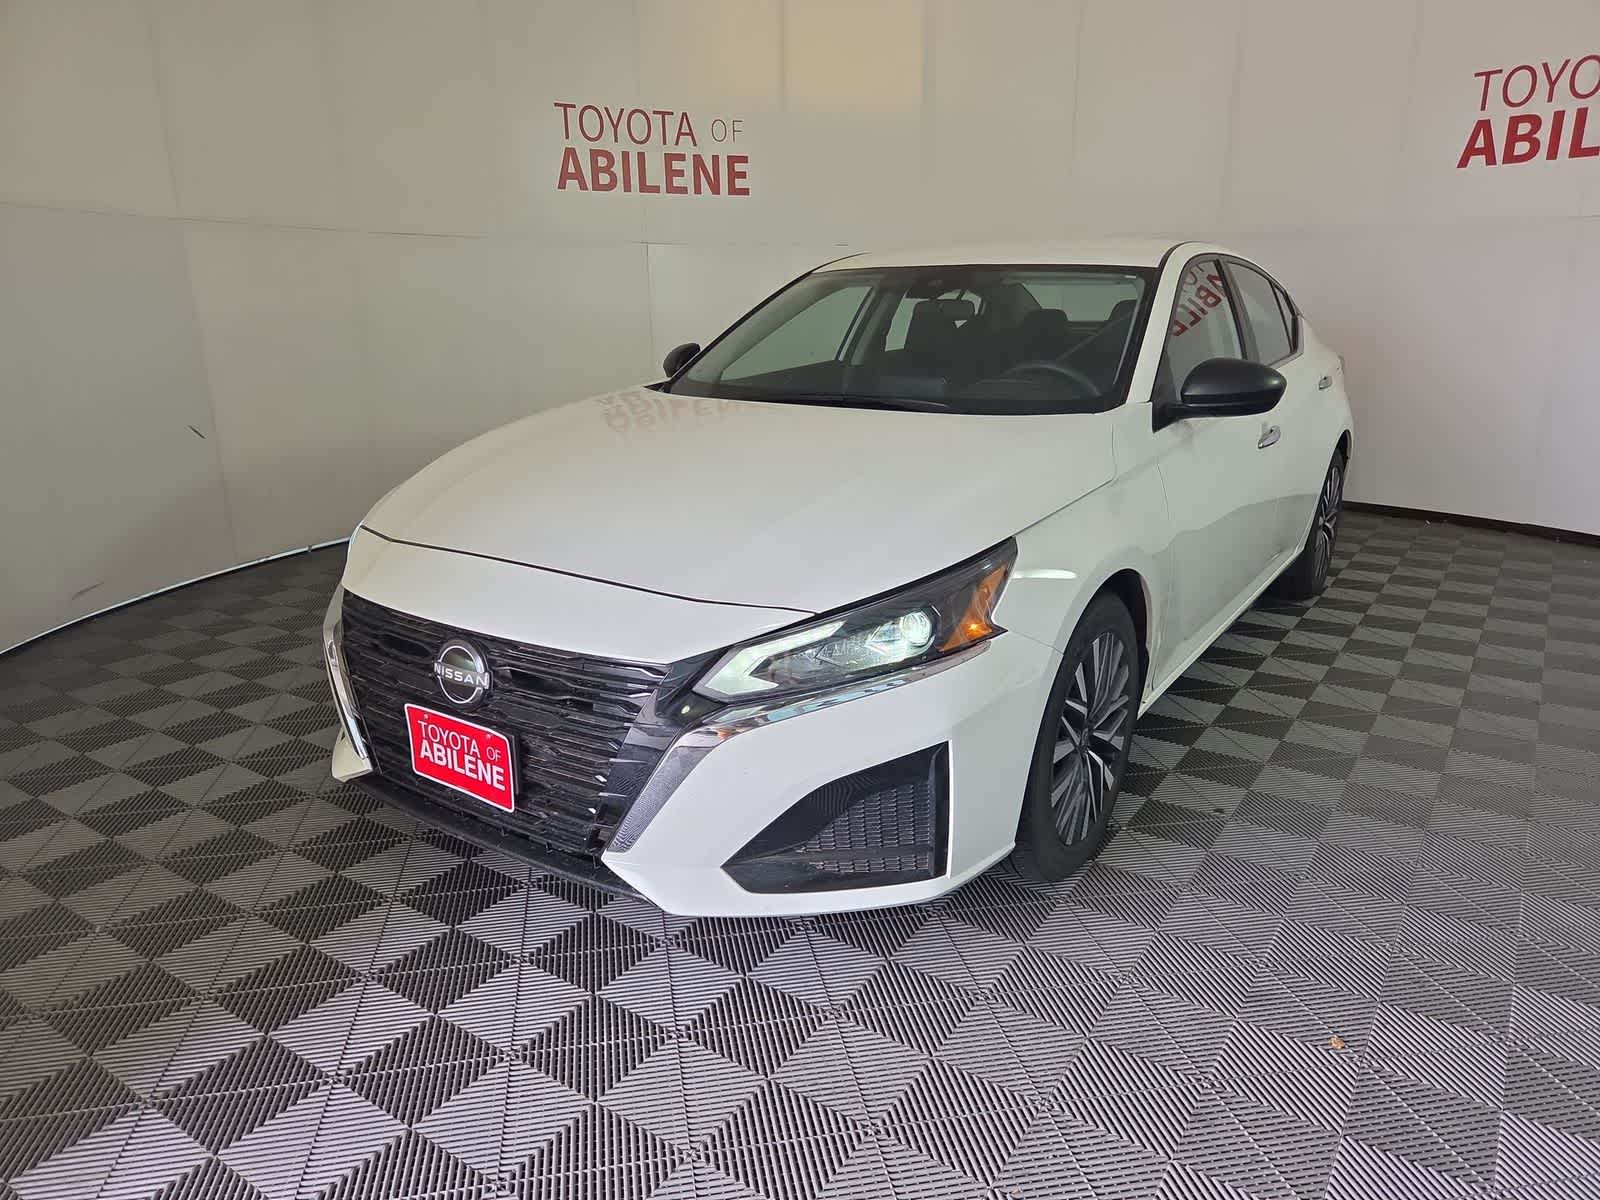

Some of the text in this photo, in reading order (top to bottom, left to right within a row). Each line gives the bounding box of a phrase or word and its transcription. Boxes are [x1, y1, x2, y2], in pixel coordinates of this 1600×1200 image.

[1474, 54, 1600, 112] TOYO
[553, 102, 743, 147] TOYOTA OF
[1456, 106, 1600, 169] ABIL
[557, 147, 750, 196] ABILENE
[433, 662, 490, 690] NISSAN
[417, 720, 502, 762] TOYOTA OF
[419, 739, 506, 792] ABILENE
